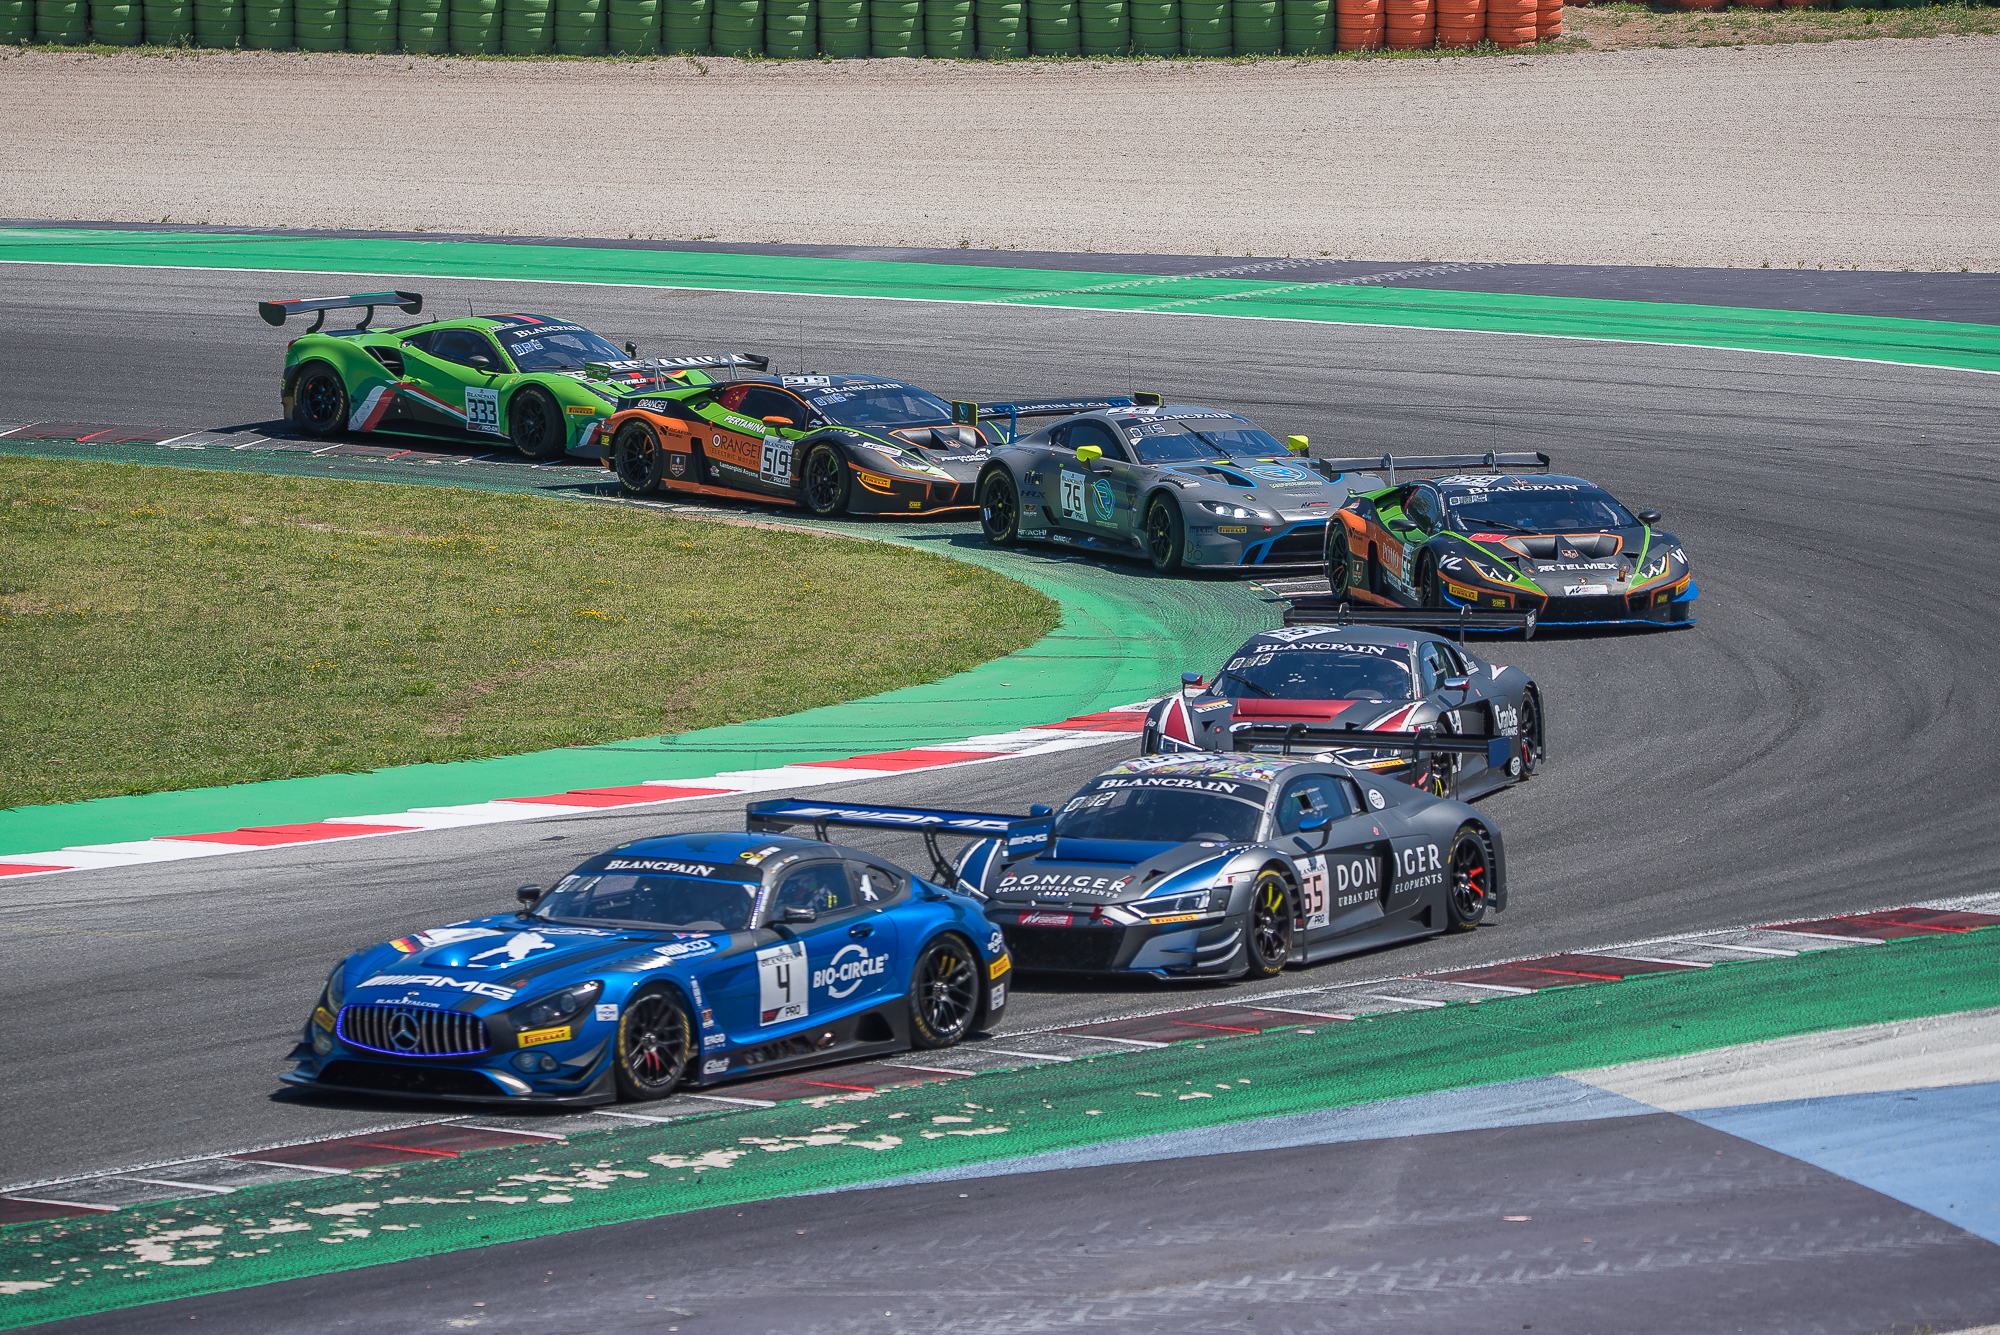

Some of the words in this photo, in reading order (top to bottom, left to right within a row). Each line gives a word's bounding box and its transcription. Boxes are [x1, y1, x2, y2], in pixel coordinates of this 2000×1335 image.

[513, 325, 585, 338] BLANCPAIN
[819, 383, 904, 394] BLANCPAIN
[468, 399, 497, 424] 333
[1137, 413, 1233, 423] BLANCPAIN
[723, 415, 767, 434] PERTAMINA
[712, 433, 761, 460] ORANGE1
[763, 447, 789, 476] 519
[864, 475, 888, 486] PIRELLI
[1063, 483, 1082, 512] 76
[1466, 485, 1579, 495] BLANCPAIN
[1556, 561, 1619, 571] TELMEX
[1253, 642, 1388, 656] BLANCPAIN
[1096, 778, 1241, 794] BLANCPAIN
[604, 860, 716, 877] BLANCPAIN
[999, 874, 1127, 893] DONIGER
[995, 885, 1032, 894] URBAN
[1032, 885, 1119, 899] DEVELOPMENTS
[1338, 892, 1364, 907] URBAN
[776, 963, 791, 1004] 4
[785, 1004, 801, 1017] PRO
[523, 1029, 566, 1045] PIRELLI
